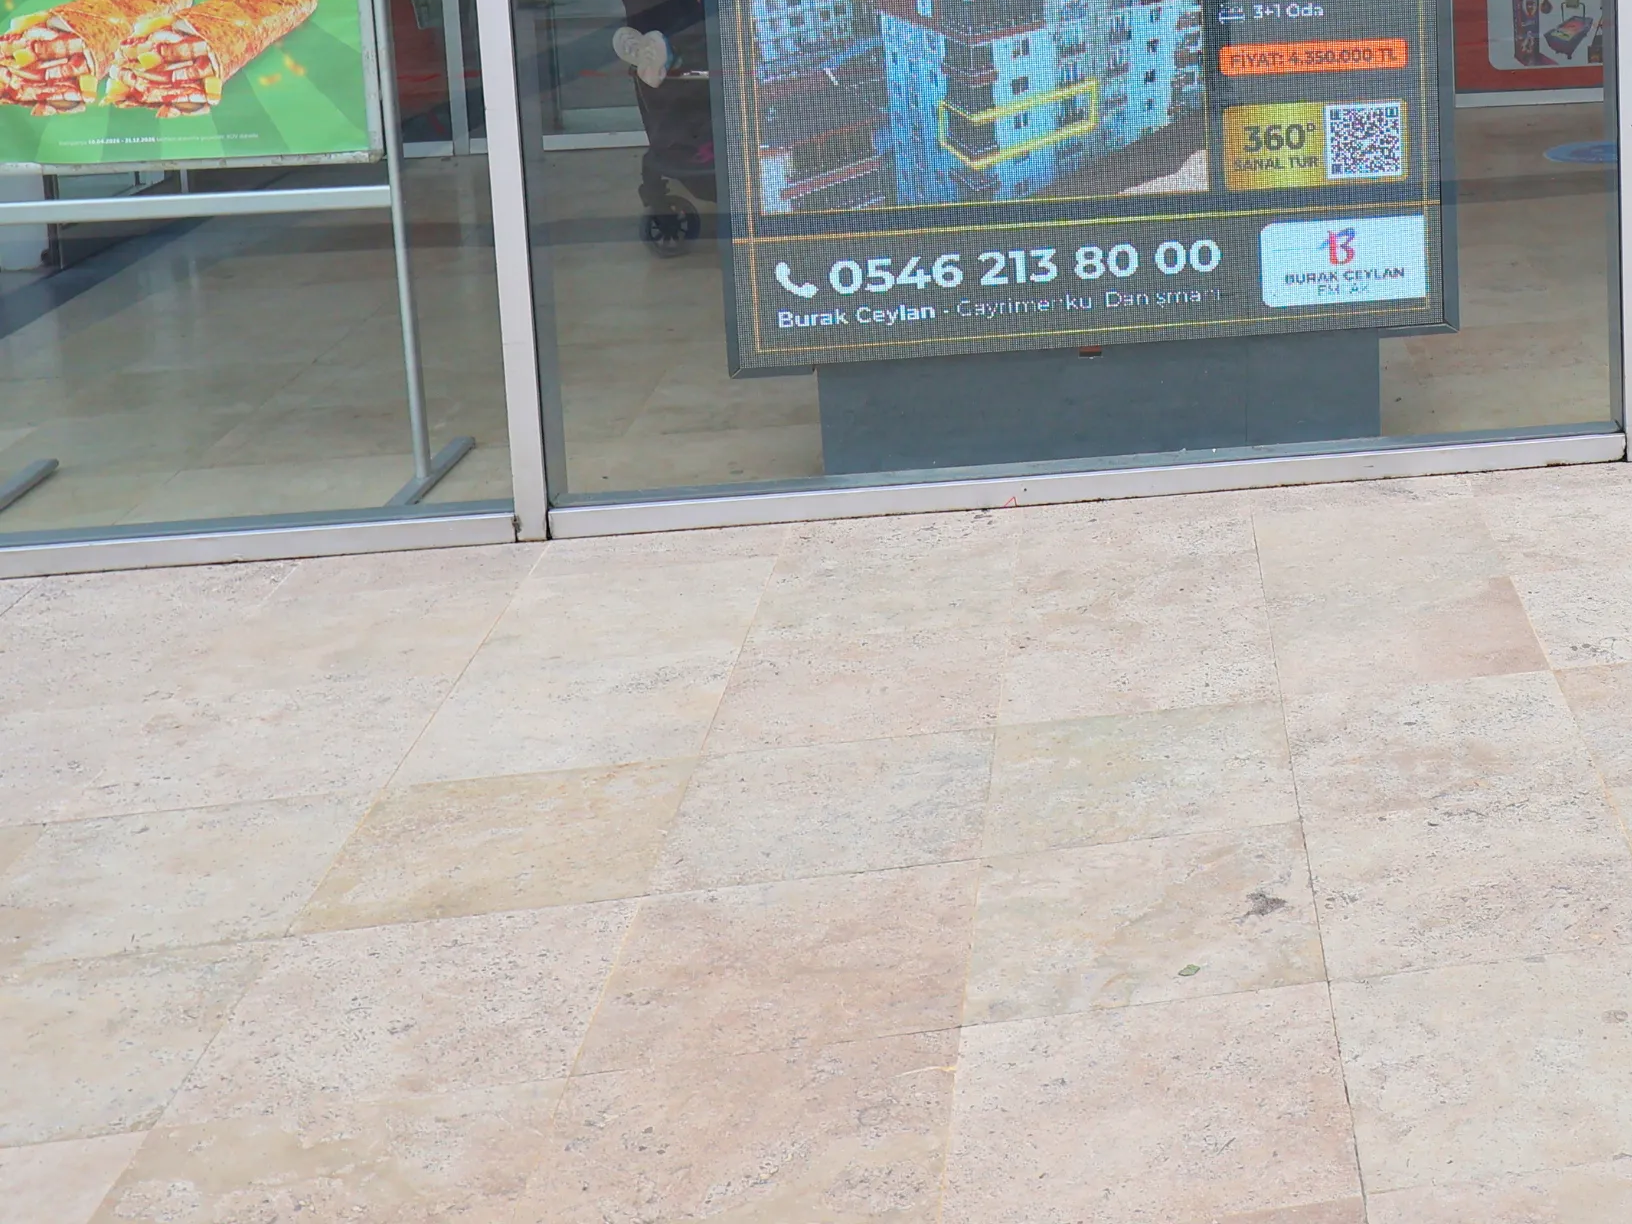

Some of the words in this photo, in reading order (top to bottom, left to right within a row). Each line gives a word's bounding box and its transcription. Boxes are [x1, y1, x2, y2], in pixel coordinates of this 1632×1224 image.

[1252, 4, 1281, 19] 3+1
[1286, 2, 1325, 18] Oda
[1378, 47, 1397, 62] TL
[828, 252, 965, 296] 0546
[976, 245, 1059, 287] 213
[1073, 242, 1140, 281] 80
[1154, 238, 1222, 275] 00
[1317, 282, 1368, 297] EMAK
[777, 308, 849, 329] Burak
[855, 304, 936, 327] Ceylan
